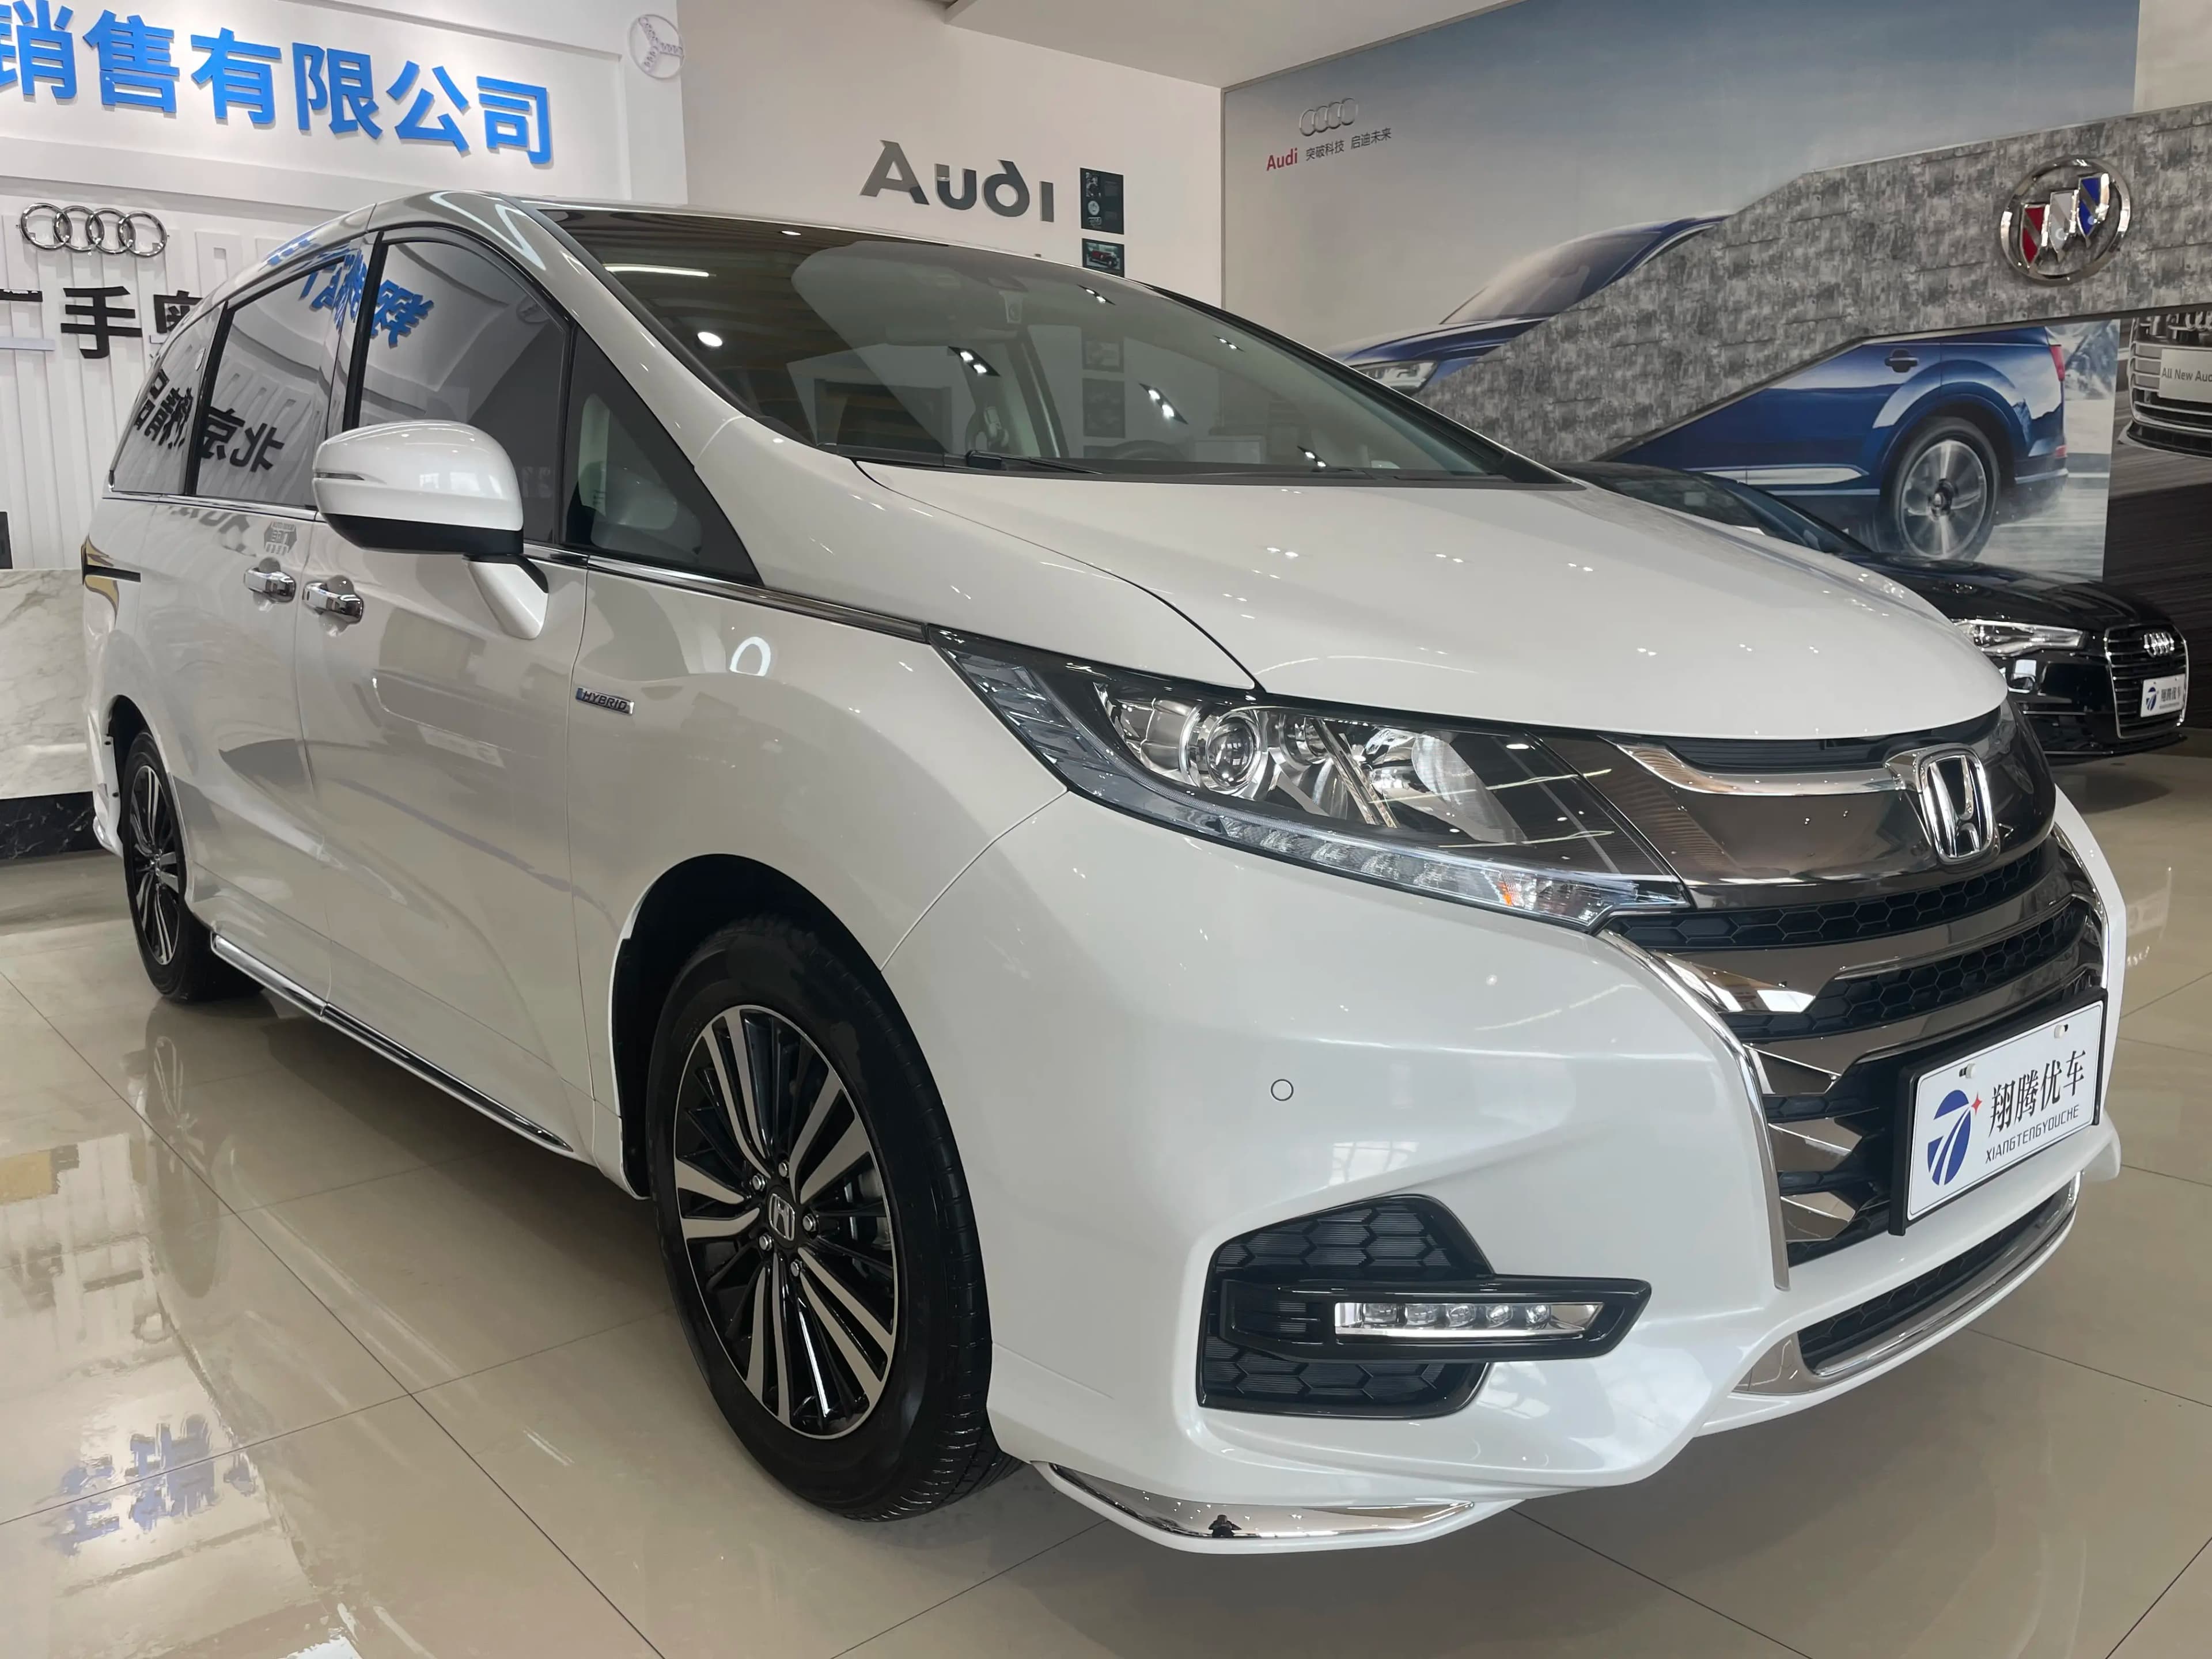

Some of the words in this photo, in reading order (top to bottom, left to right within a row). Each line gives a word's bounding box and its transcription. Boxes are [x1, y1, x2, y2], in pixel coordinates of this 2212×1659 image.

[0, 0, 554, 164] 销售有限公司
[1266, 147, 1298, 171] Audi
[1306, 140, 1344, 161] 突破科技
[1351, 127, 1392, 150] 启迪未来
[859, 139, 1054, 222] Audi
[2161, 367, 2172, 378] All
[2175, 369, 2193, 380] New
[582, 691, 628, 710] HYBRID
[1988, 1050, 2086, 1138] 翔腾优车
[1986, 1104, 2080, 1164] XIANGTENGYOUCHE
